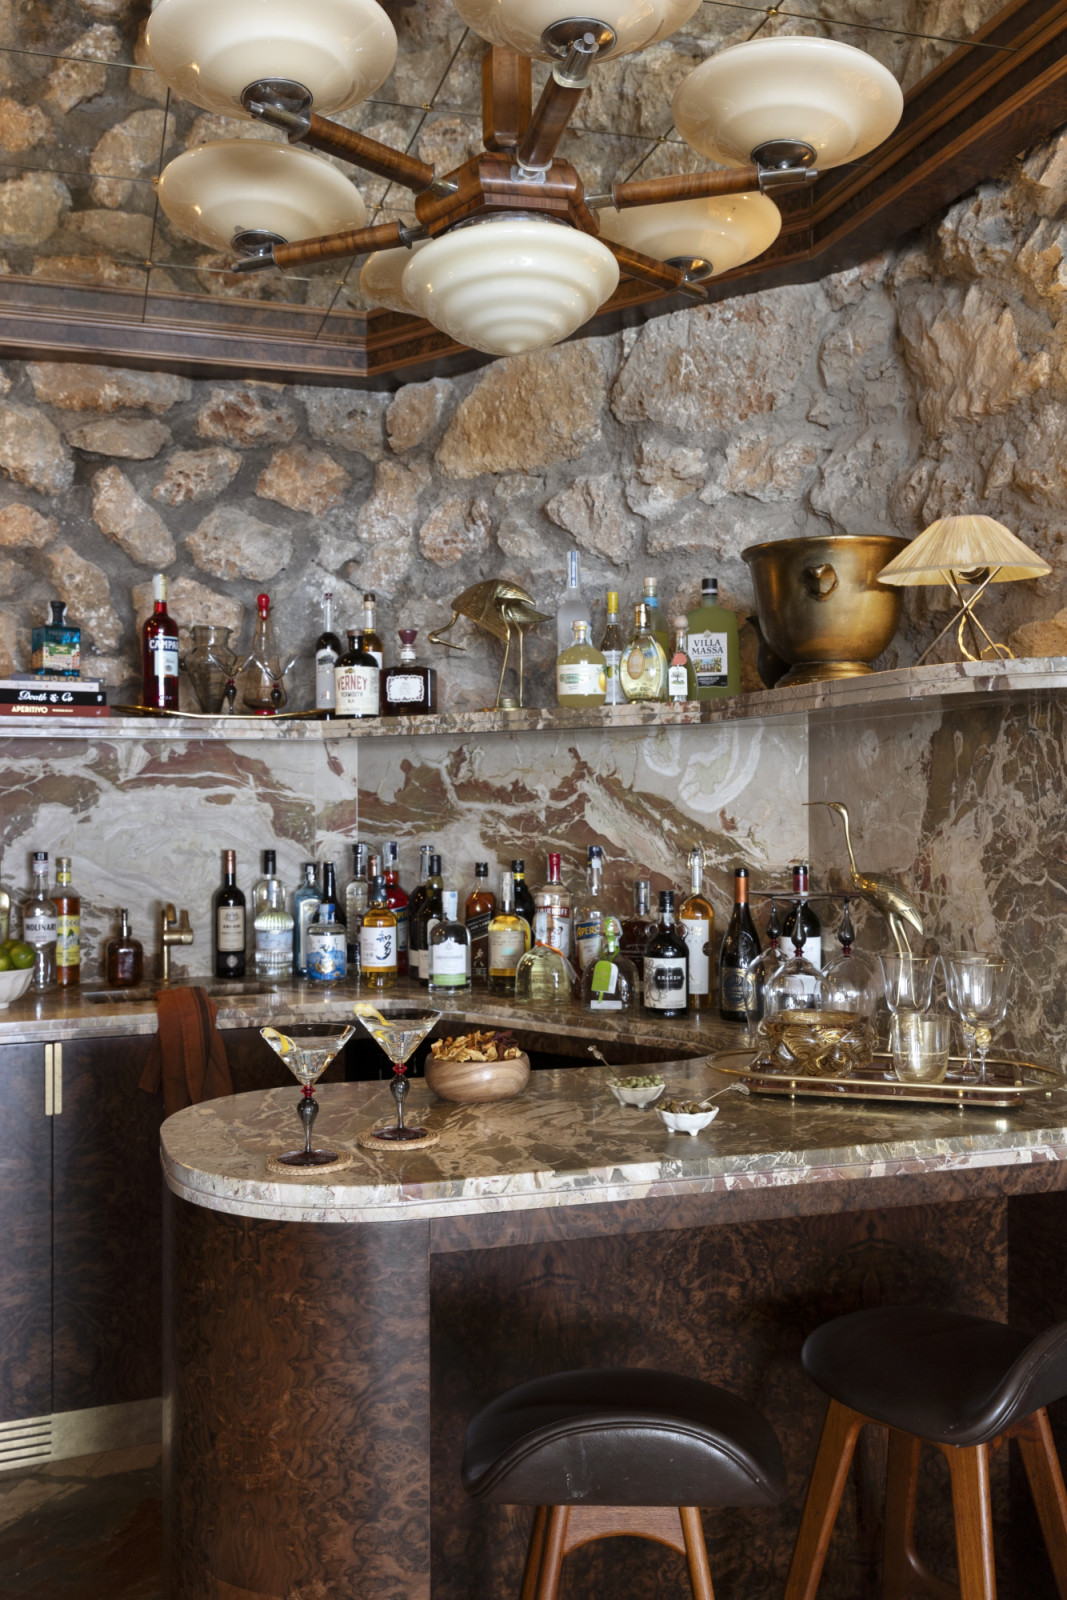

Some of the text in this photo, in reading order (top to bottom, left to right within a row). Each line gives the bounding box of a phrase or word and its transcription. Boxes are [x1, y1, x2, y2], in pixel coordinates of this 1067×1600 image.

[149, 640, 179, 650] CAMPA
[694, 639, 721, 647] VILLA
[692, 647, 724, 655] MASSA
[338, 675, 367, 690] VERNEY
[18, 690, 73, 703] Death & Co
[11, 705, 49, 714] APERITIVO
[577, 924, 601, 937] APERO
